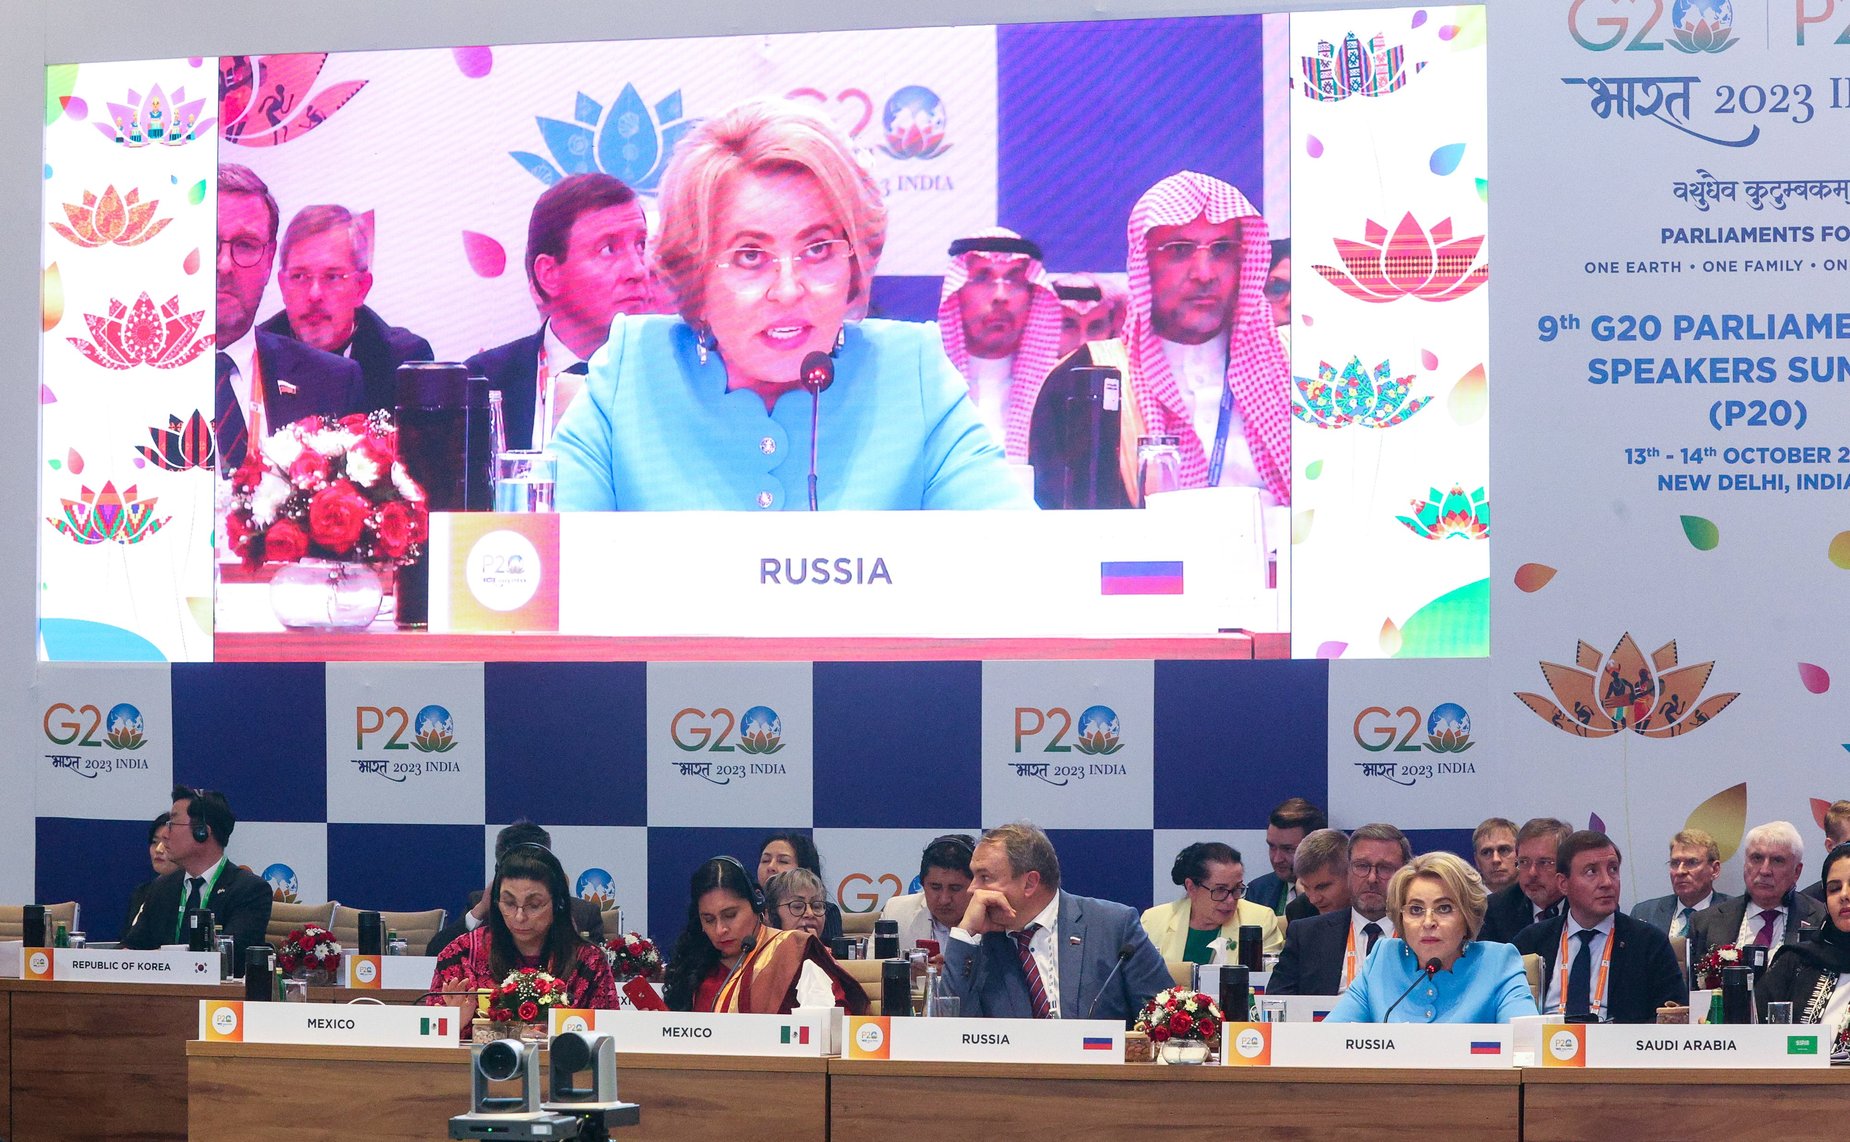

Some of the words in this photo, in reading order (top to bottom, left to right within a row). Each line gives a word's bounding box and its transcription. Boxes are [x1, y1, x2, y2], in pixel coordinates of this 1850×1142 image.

[1714, 84, 1814, 124] 2023
[1829, 77, 1850, 109] I
[1661, 226, 1815, 244] PARLIAMENTS
[1584, 262, 1620, 274] ONE
[1626, 261, 1682, 273] EARTH
[1703, 260, 1738, 273] ONE
[1745, 259, 1804, 272] FAMILY
[1824, 259, 1848, 271] ON
[1538, 313, 1580, 342] 9th
[1591, 314, 1662, 342] G20
[1673, 313, 1850, 341] PARLIAME
[1588, 356, 1777, 385] SPEAKERS
[1709, 399, 1808, 432] (P20)
[1624, 446, 1660, 464] 13th
[1680, 446, 1717, 464] 14th
[1723, 446, 1831, 464] OCTOBER
[1837, 446, 1850, 463] 2
[1658, 474, 1711, 491] NEW
[1718, 473, 1790, 494] DELHI,
[760, 557, 893, 585] RUSSIA
[85, 759, 112, 773] 2023
[116, 758, 149, 769] INDIA
[393, 762, 422, 776] 2023
[426, 761, 460, 772] INDIA
[716, 765, 746, 779] 2023
[750, 763, 787, 775] INDIA
[1054, 766, 1085, 780] 2023
[1089, 764, 1127, 775] INDIA
[1401, 765, 1433, 778] 2023
[1437, 762, 1476, 774] INDIA
[837, 873, 923, 913] G2
[72, 960, 119, 970] REPUBLIC
[121, 961, 135, 971] OF
[137, 962, 171, 972] KOREA
[307, 1018, 355, 1030] MEXICO
[662, 1026, 712, 1038] MEXICO
[962, 1033, 1010, 1045] RUSSIA
[1345, 1039, 1395, 1050] RUSSIA
[1636, 1039, 1678, 1051] SAUDI
[1683, 1039, 1737, 1051] ARABIA
